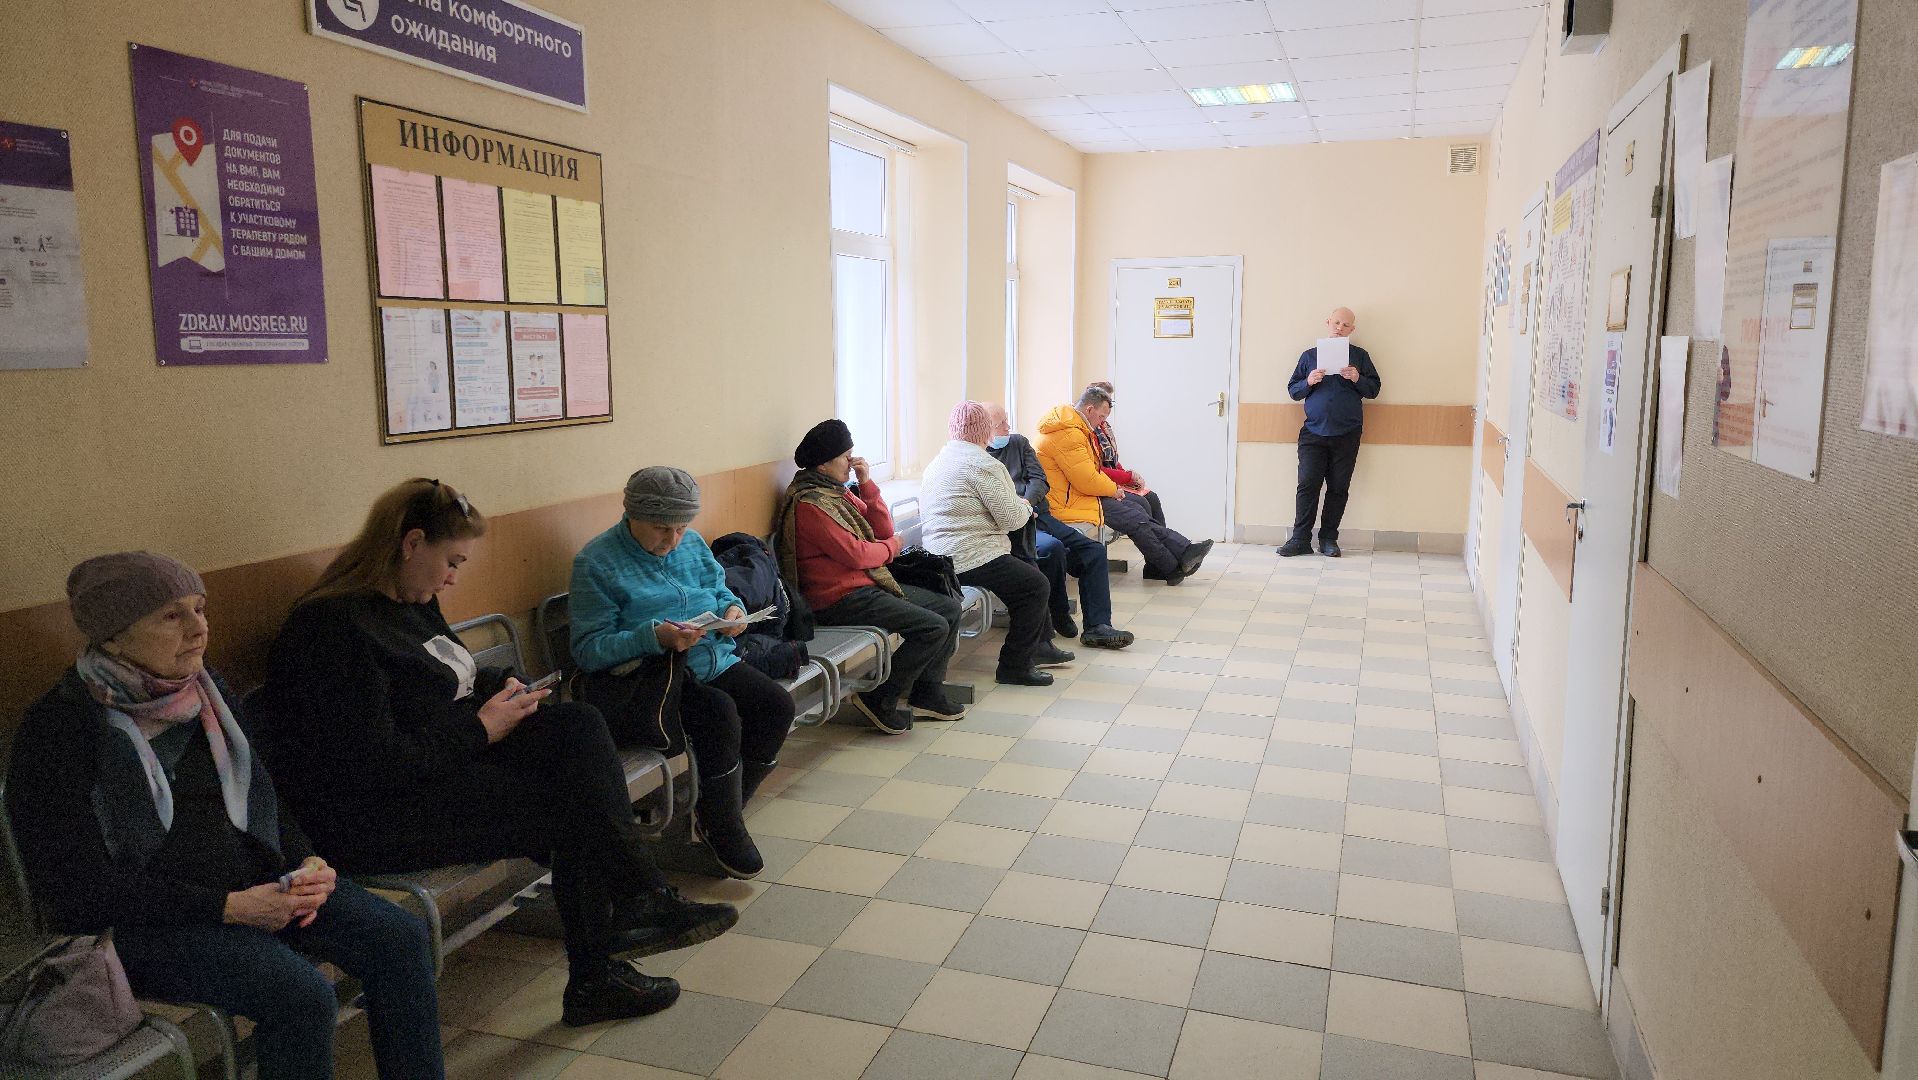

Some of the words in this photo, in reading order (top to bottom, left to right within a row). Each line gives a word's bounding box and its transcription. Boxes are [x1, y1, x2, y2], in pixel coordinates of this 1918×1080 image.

[449, 0, 572, 58] комфортного
[391, 15, 497, 63] ожидания
[223, 129, 241, 141] ДЛЯ
[243, 132, 278, 148] ПОДАЧИ
[224, 145, 281, 165] ДОКУМЕНТОВ
[398, 119, 579, 181] ИНФОРМАЦИЯ
[226, 162, 238, 174] НА
[262, 167, 280, 180] ВАМ
[227, 178, 285, 196] НЕОБХОДИМО
[228, 195, 281, 211] ОБРАТИТЬСЯ
[230, 211, 237, 223] К
[238, 212, 297, 229] УЧАСТКОВОМУ
[230, 228, 277, 242] ТЕРАПЕВТУ
[278, 233, 308, 245] РЯДОМ
[232, 244, 239, 256] С
[240, 245, 274, 258] ВАШИМ
[275, 248, 306, 260] ДОМОМ
[178, 313, 308, 332] ZDRAV.MOSREG.RU
